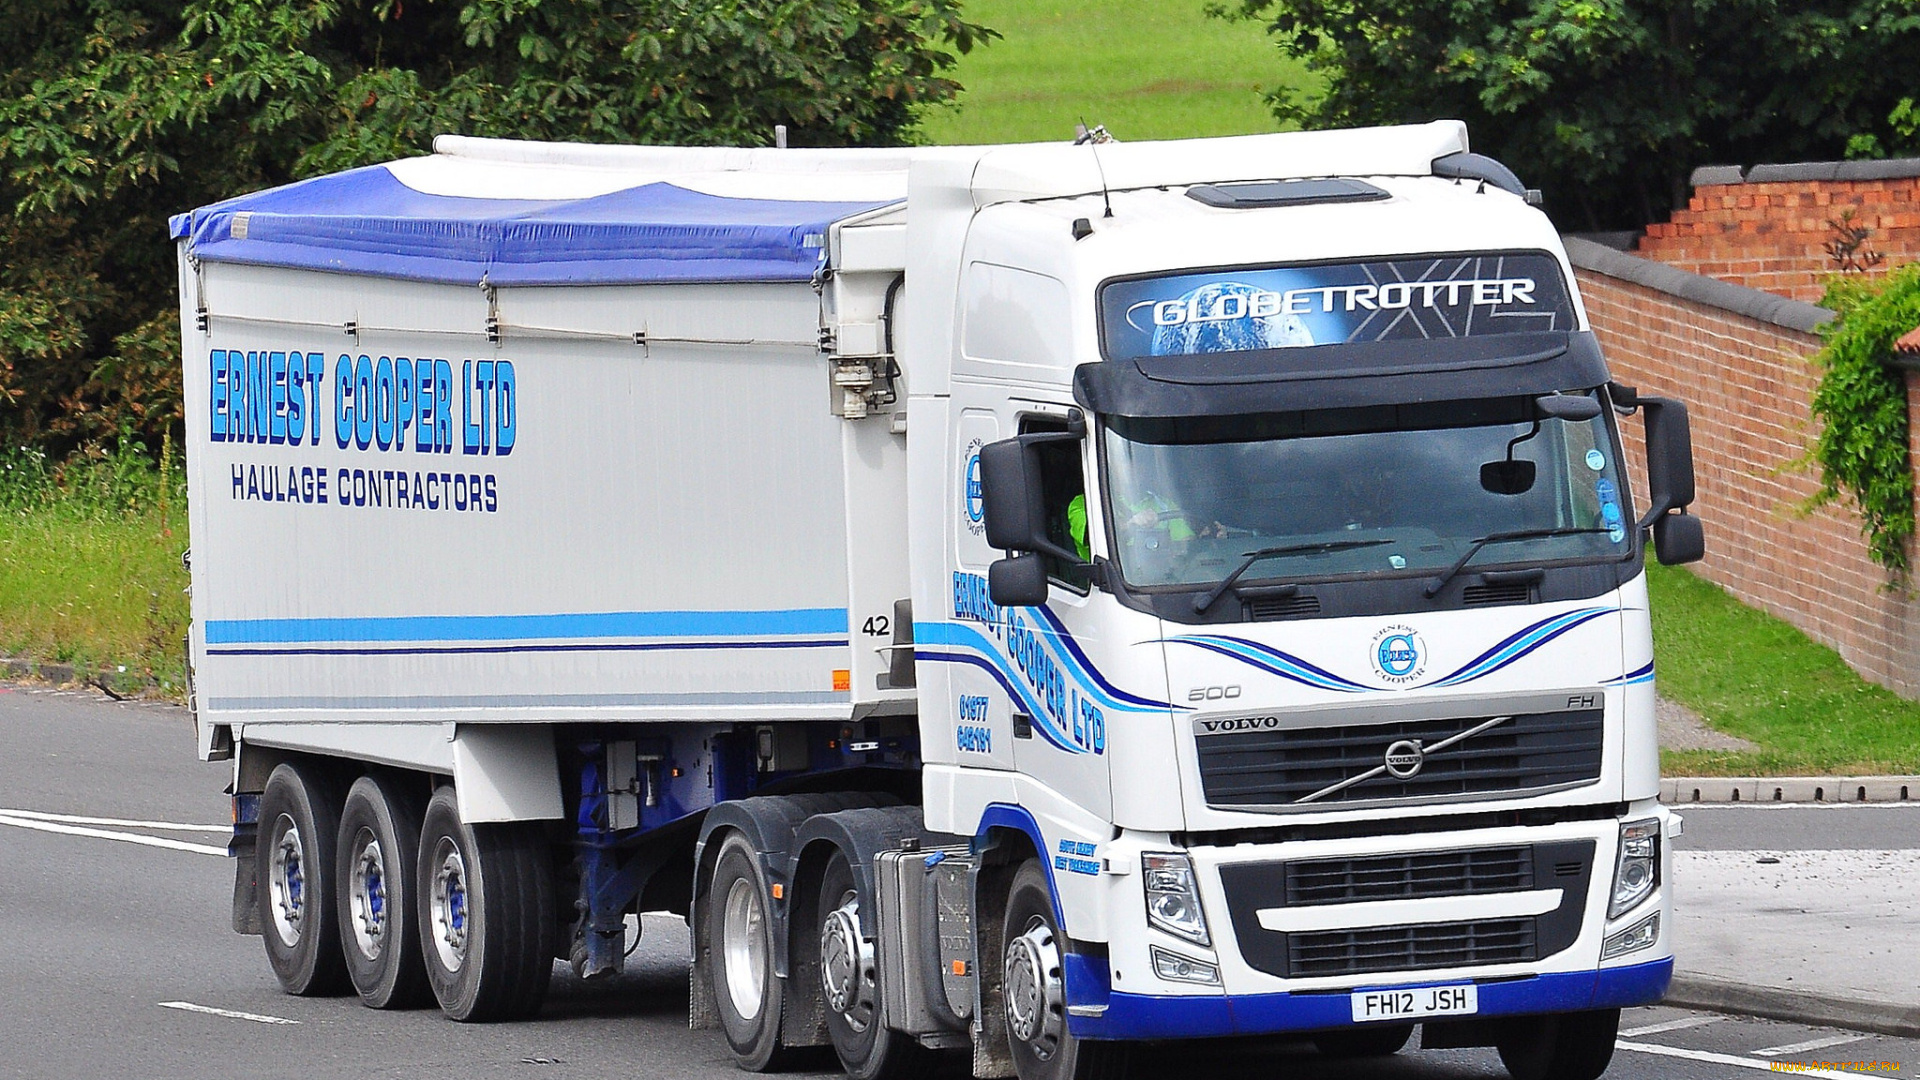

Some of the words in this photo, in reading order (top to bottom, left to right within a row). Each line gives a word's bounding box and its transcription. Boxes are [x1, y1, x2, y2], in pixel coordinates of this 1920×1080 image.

[1153, 278, 1536, 326] GLOBETROTTER
[210, 349, 324, 445] ERNEST
[335, 354, 453, 453] COOPER
[462, 360, 517, 456] LTD
[232, 464, 328, 503] HAULAGE
[338, 468, 498, 512] CONTRACTORS
[862, 615, 890, 637] 42
[1372, 624, 1418, 641] ERNEST
[1007, 605, 1067, 731] COOPER
[1072, 688, 1106, 755] LTD
[1374, 667, 1425, 684] COOPER
[960, 694, 989, 722] 01977
[1567, 695, 1595, 709] FH
[1202, 716, 1279, 732] VOLVO
[1365, 993, 1414, 1016] FH12
[1425, 988, 1466, 1011] JSH
